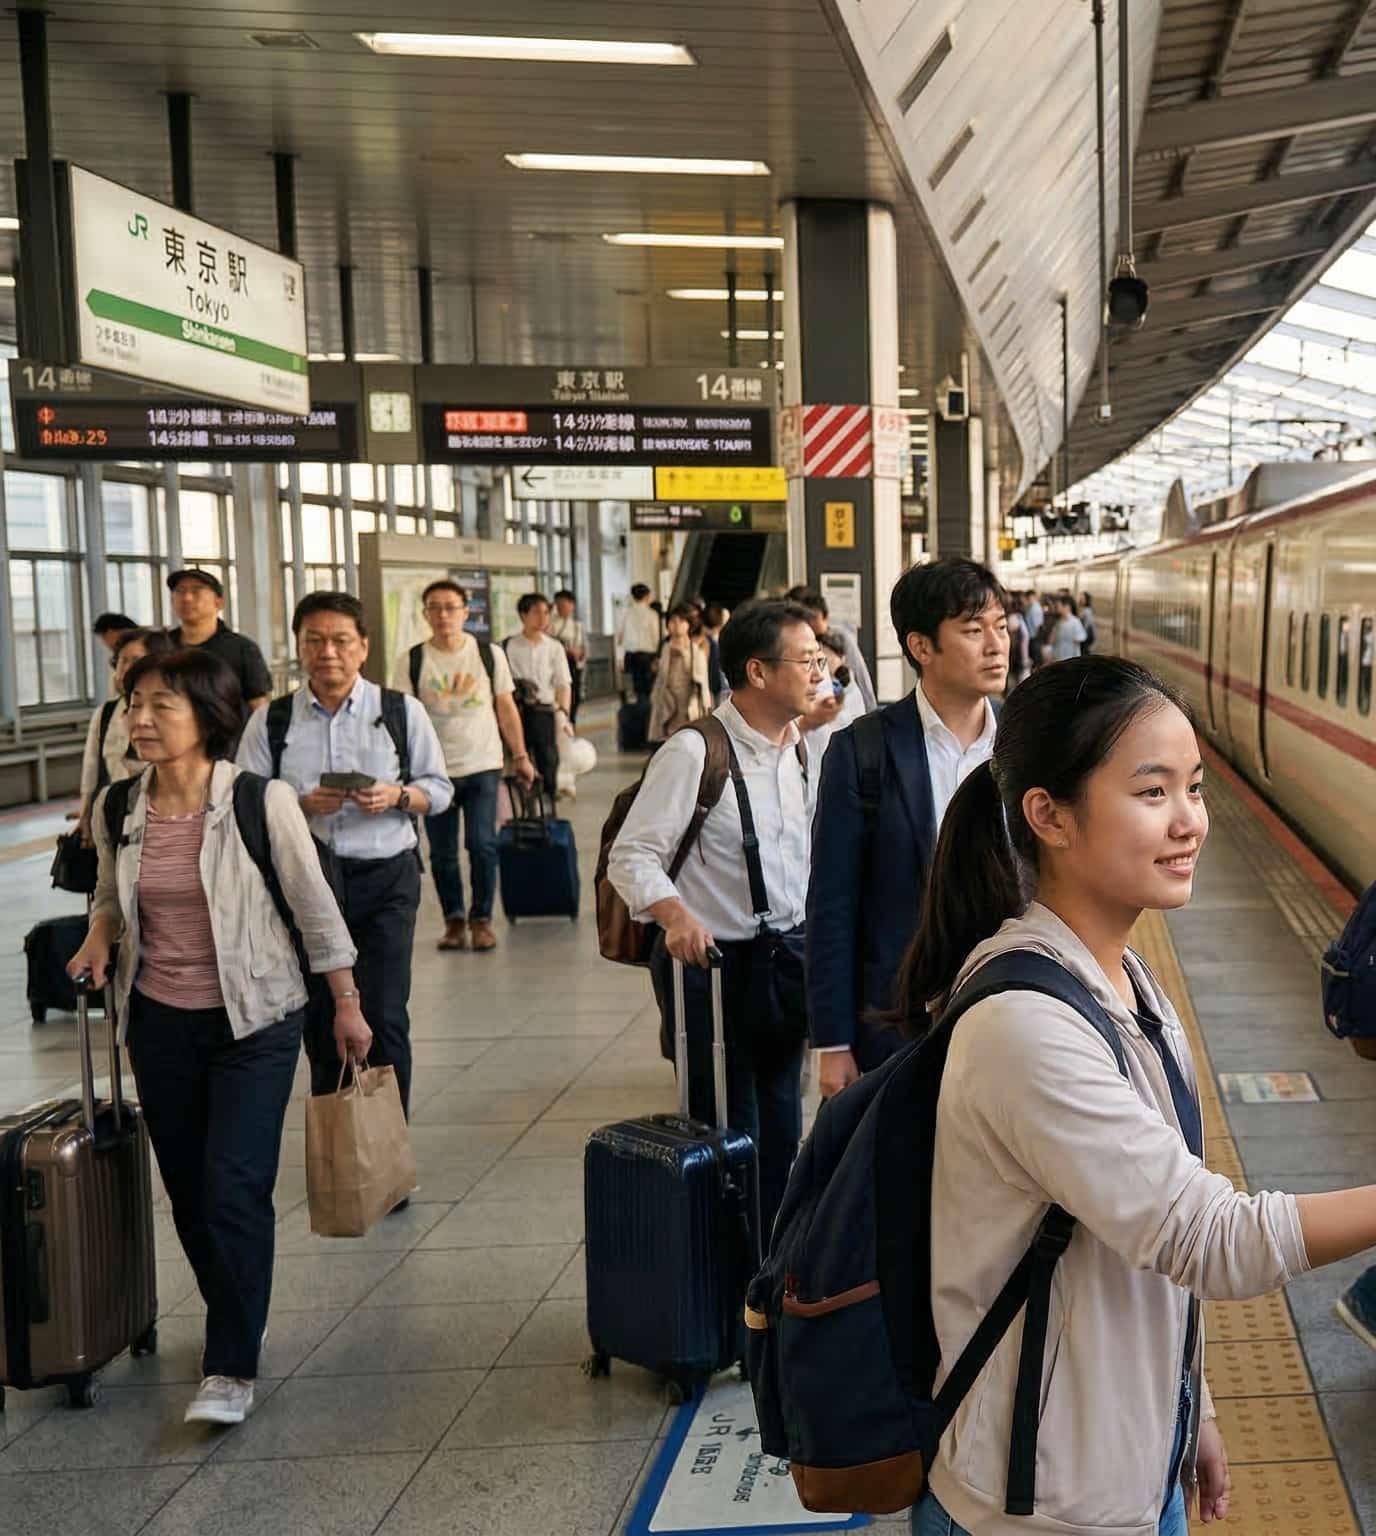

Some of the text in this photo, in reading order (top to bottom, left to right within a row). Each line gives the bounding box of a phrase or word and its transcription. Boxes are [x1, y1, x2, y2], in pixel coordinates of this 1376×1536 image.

[127, 213, 148, 240] JR
[162, 226, 249, 297] 東京駅
[186, 285, 230, 324] Tokyo
[704, 1413, 737, 1437] JR
